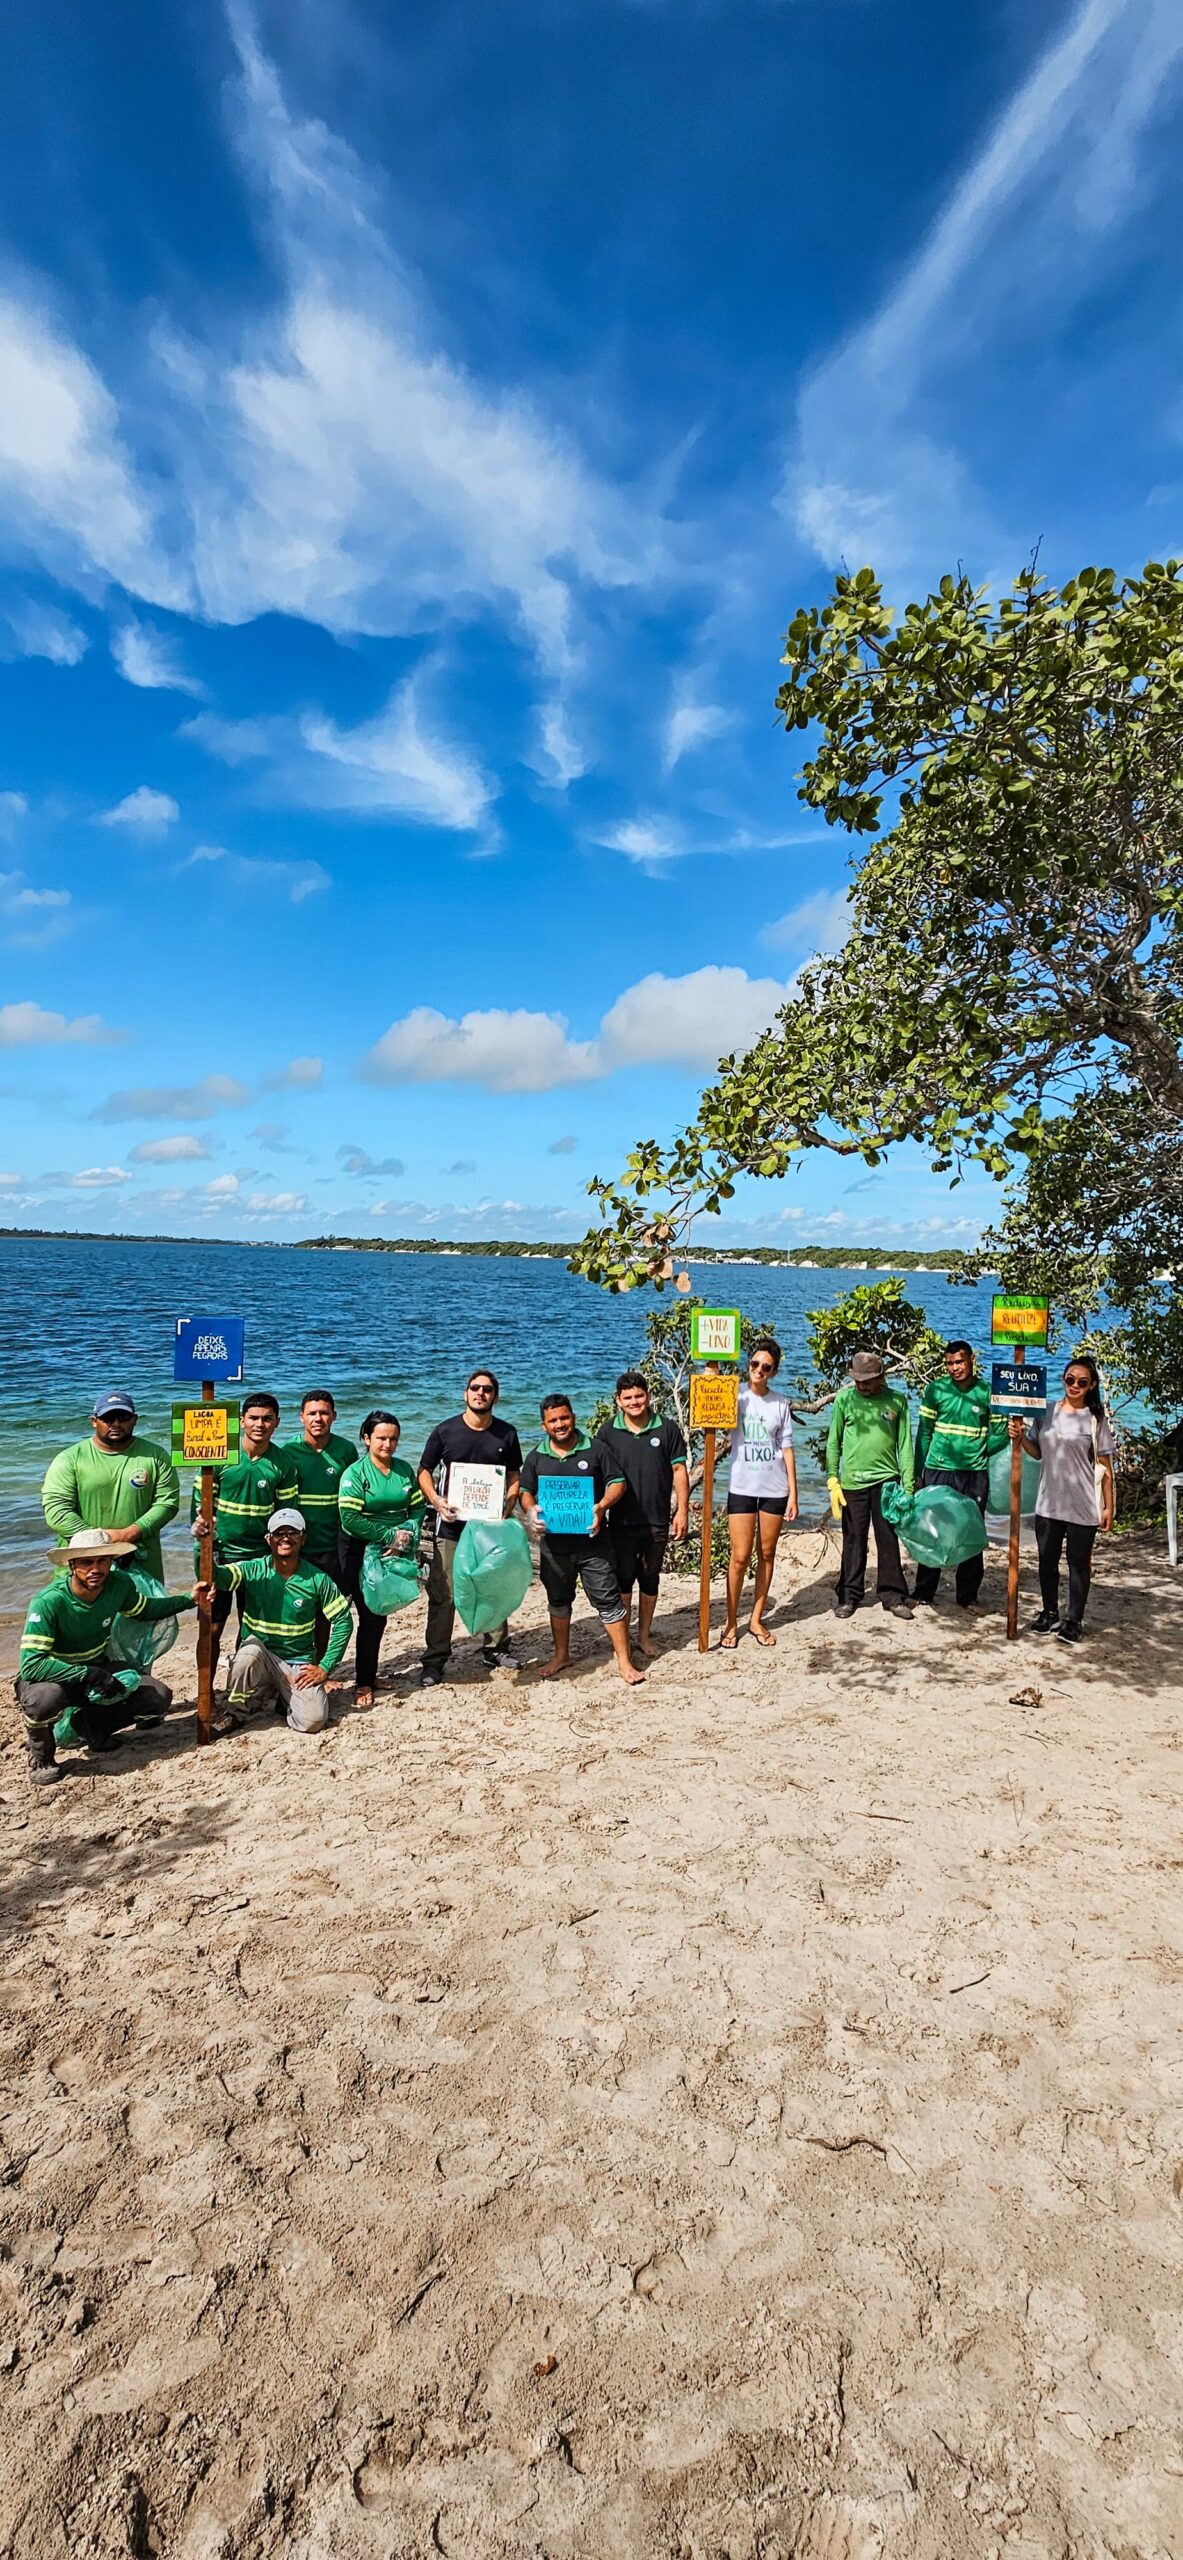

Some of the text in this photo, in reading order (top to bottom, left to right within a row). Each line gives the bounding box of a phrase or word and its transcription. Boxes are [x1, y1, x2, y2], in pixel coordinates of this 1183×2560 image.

[198, 1336, 225, 1345] DEIXE
[194, 1343, 227, 1352] APENAS
[192, 1351, 228, 1360] PEGADAS
[1000, 1370, 1015, 1379] SEU
[1008, 1381, 1030, 1392] SUA
[190, 1418, 213, 1429] LIMPA
[184, 1445, 226, 1458] CONSCIENTE
[744, 1446, 776, 1462] LIXO!
[545, 1480, 580, 1490] PRESERVAR
[541, 1490, 588, 1500] A NATUREZA
[552, 1501, 590, 1512] PRESERVAR
[549, 1516, 555, 1525] A
